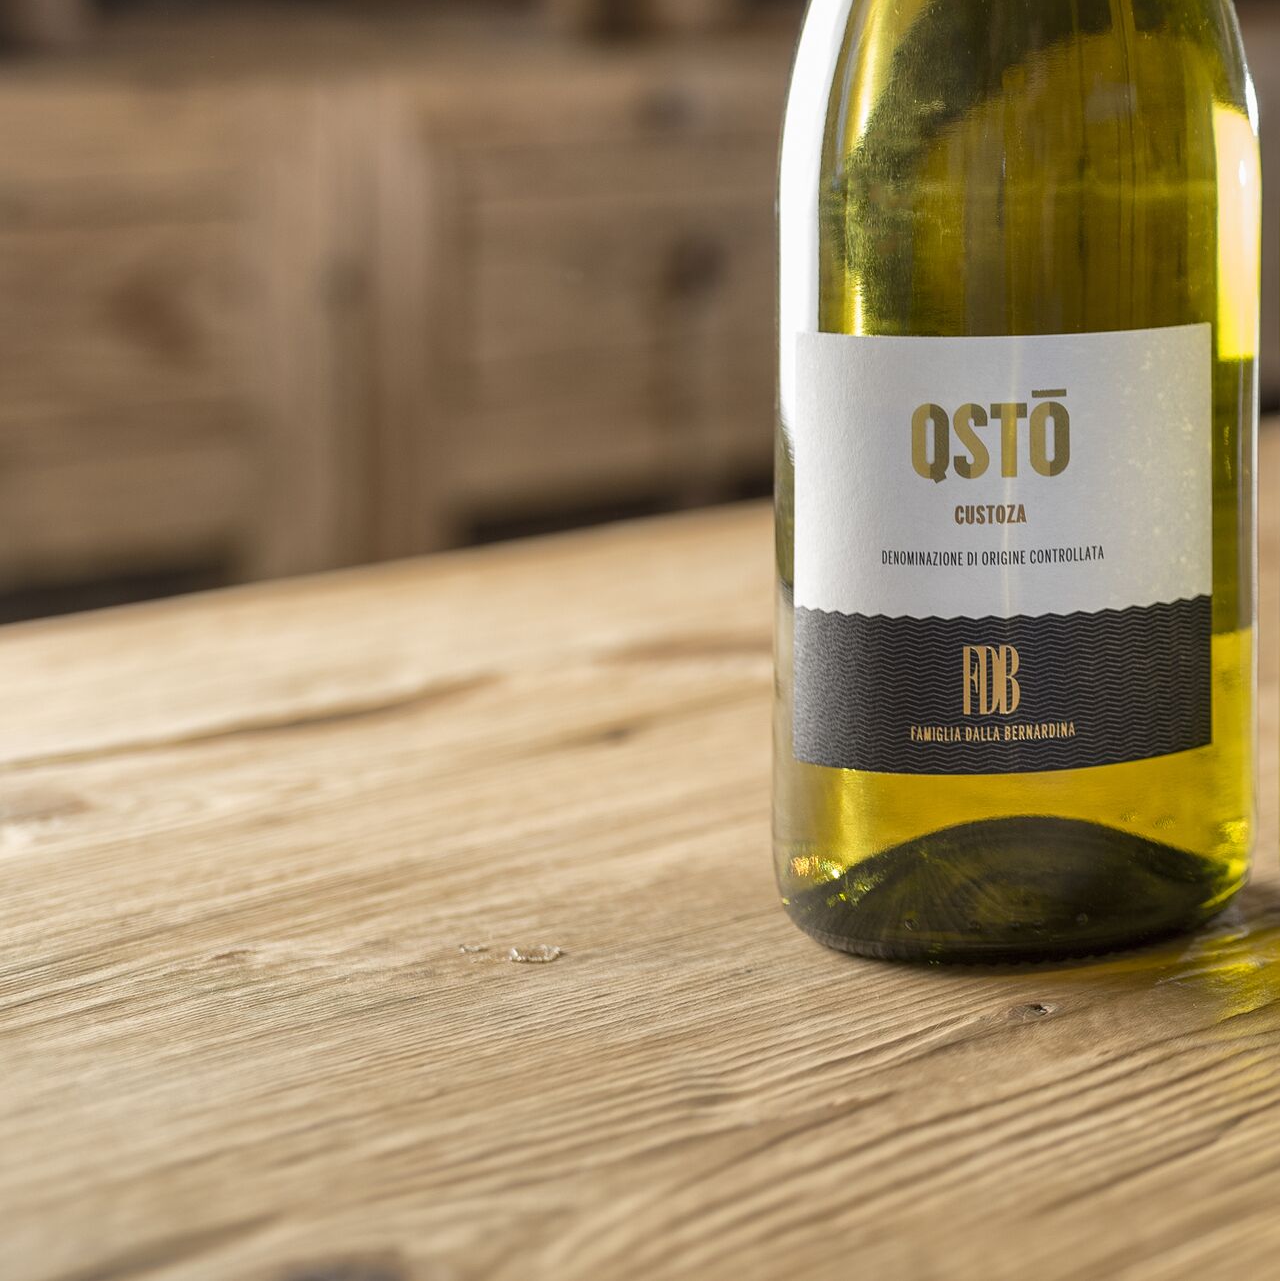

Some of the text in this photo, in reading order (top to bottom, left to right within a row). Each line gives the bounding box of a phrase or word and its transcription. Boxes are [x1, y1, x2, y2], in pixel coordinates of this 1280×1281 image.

[954, 503, 1027, 526] CUSTOZA
[881, 544, 1106, 567] DENOMINAZIONE DI ORIGINE CONTROLLATA
[962, 644, 1022, 716] FDB
[910, 722, 1076, 743] FAMIGLIA DALLA BERNARDINA
